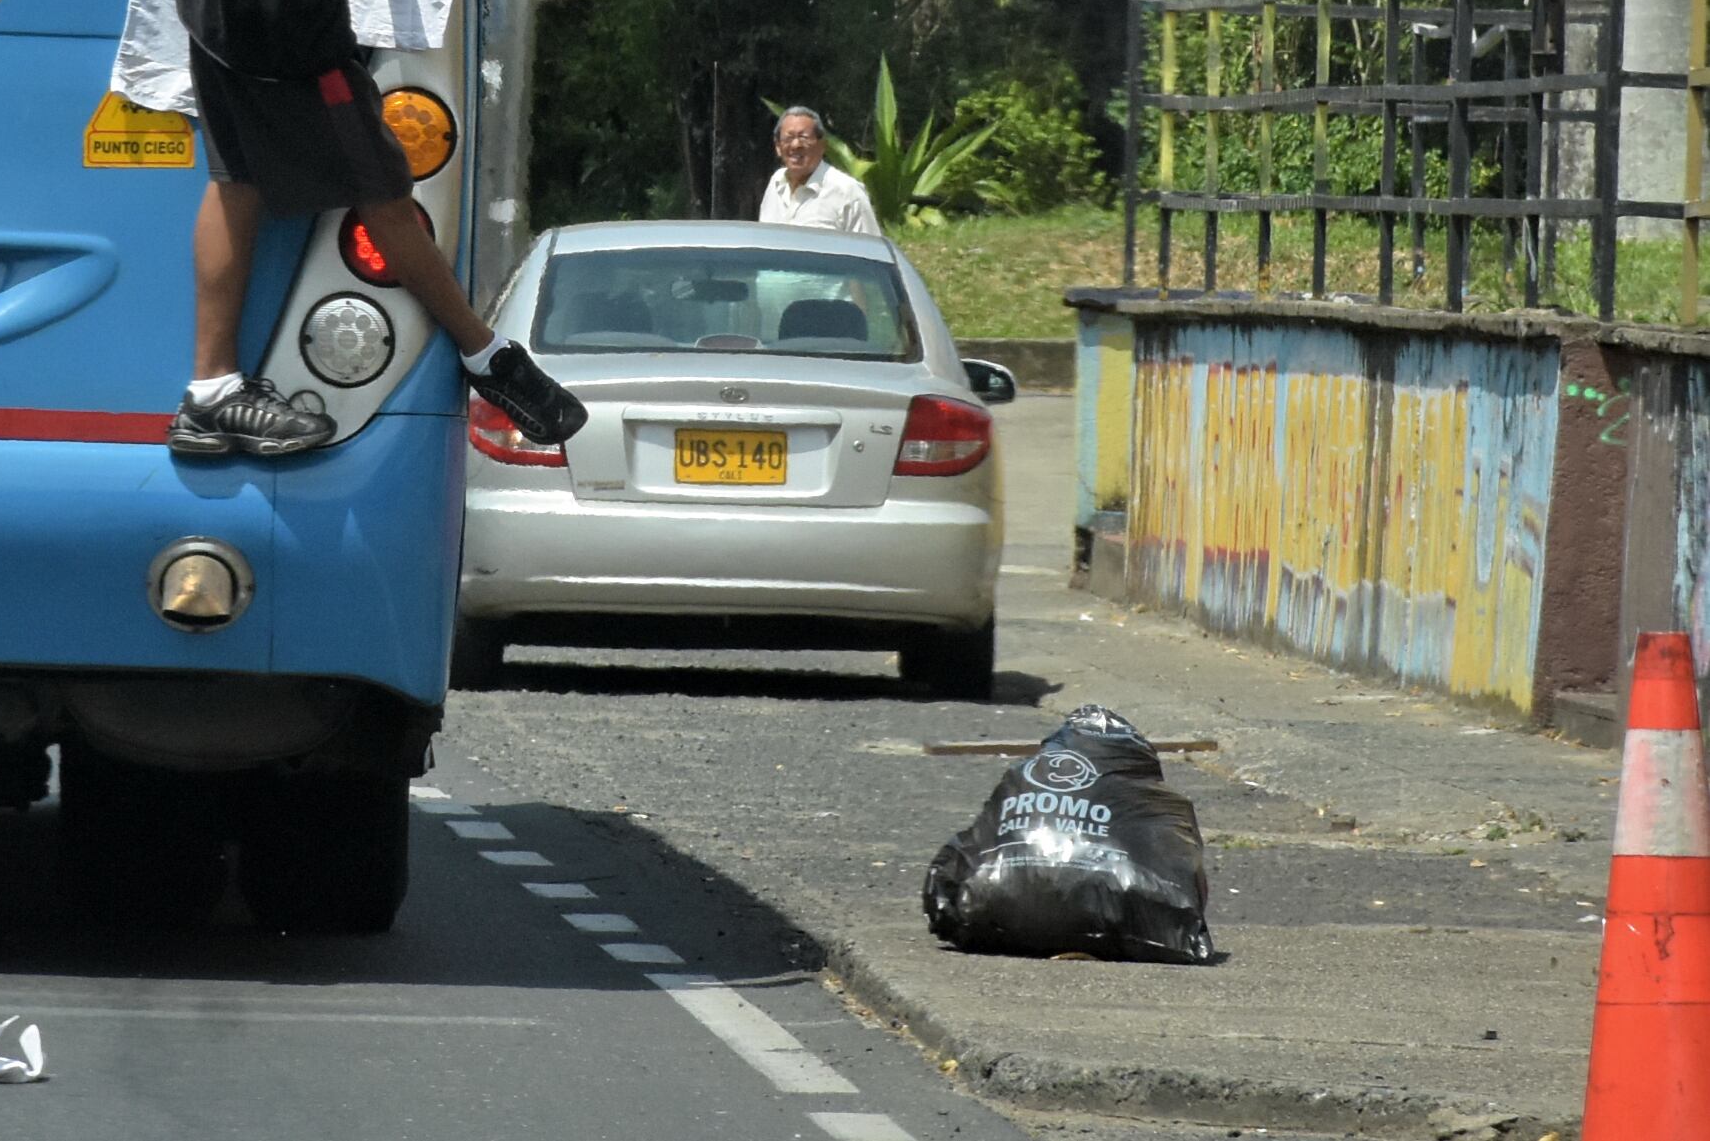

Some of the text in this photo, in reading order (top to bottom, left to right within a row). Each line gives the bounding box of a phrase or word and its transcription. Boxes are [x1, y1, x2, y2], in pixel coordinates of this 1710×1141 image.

[93, 141, 186, 154] PUNTO CIEGO
[679, 439, 783, 470] UBS 140
[1000, 792, 1112, 823] PROMO
[997, 816, 1110, 837] CALI VALLE
